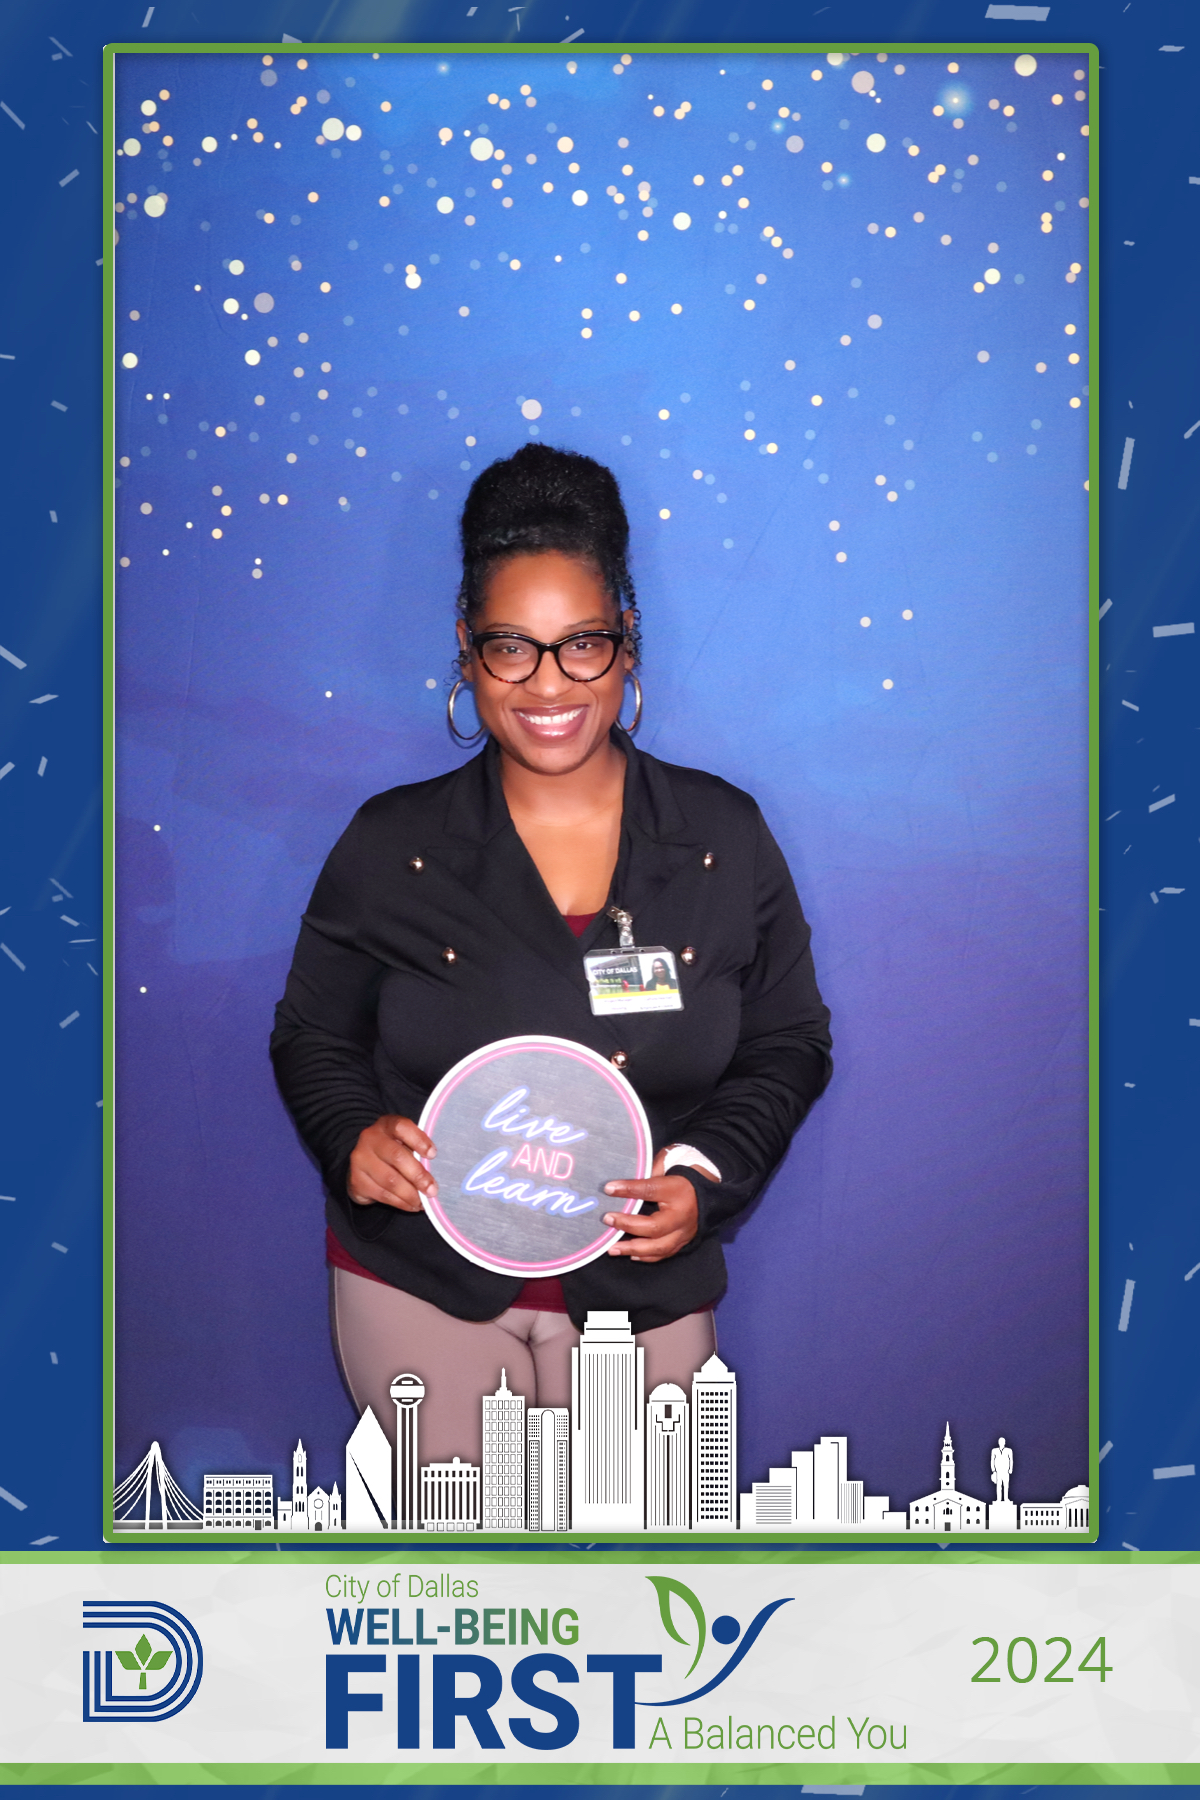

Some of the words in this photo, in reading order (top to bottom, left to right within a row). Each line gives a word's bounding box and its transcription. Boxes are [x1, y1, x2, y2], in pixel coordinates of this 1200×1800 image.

[616, 966, 638, 974] DALLAS
[483, 1086, 587, 1145] live
[464, 1148, 596, 1216] learn
[511, 1143, 574, 1180] AND
